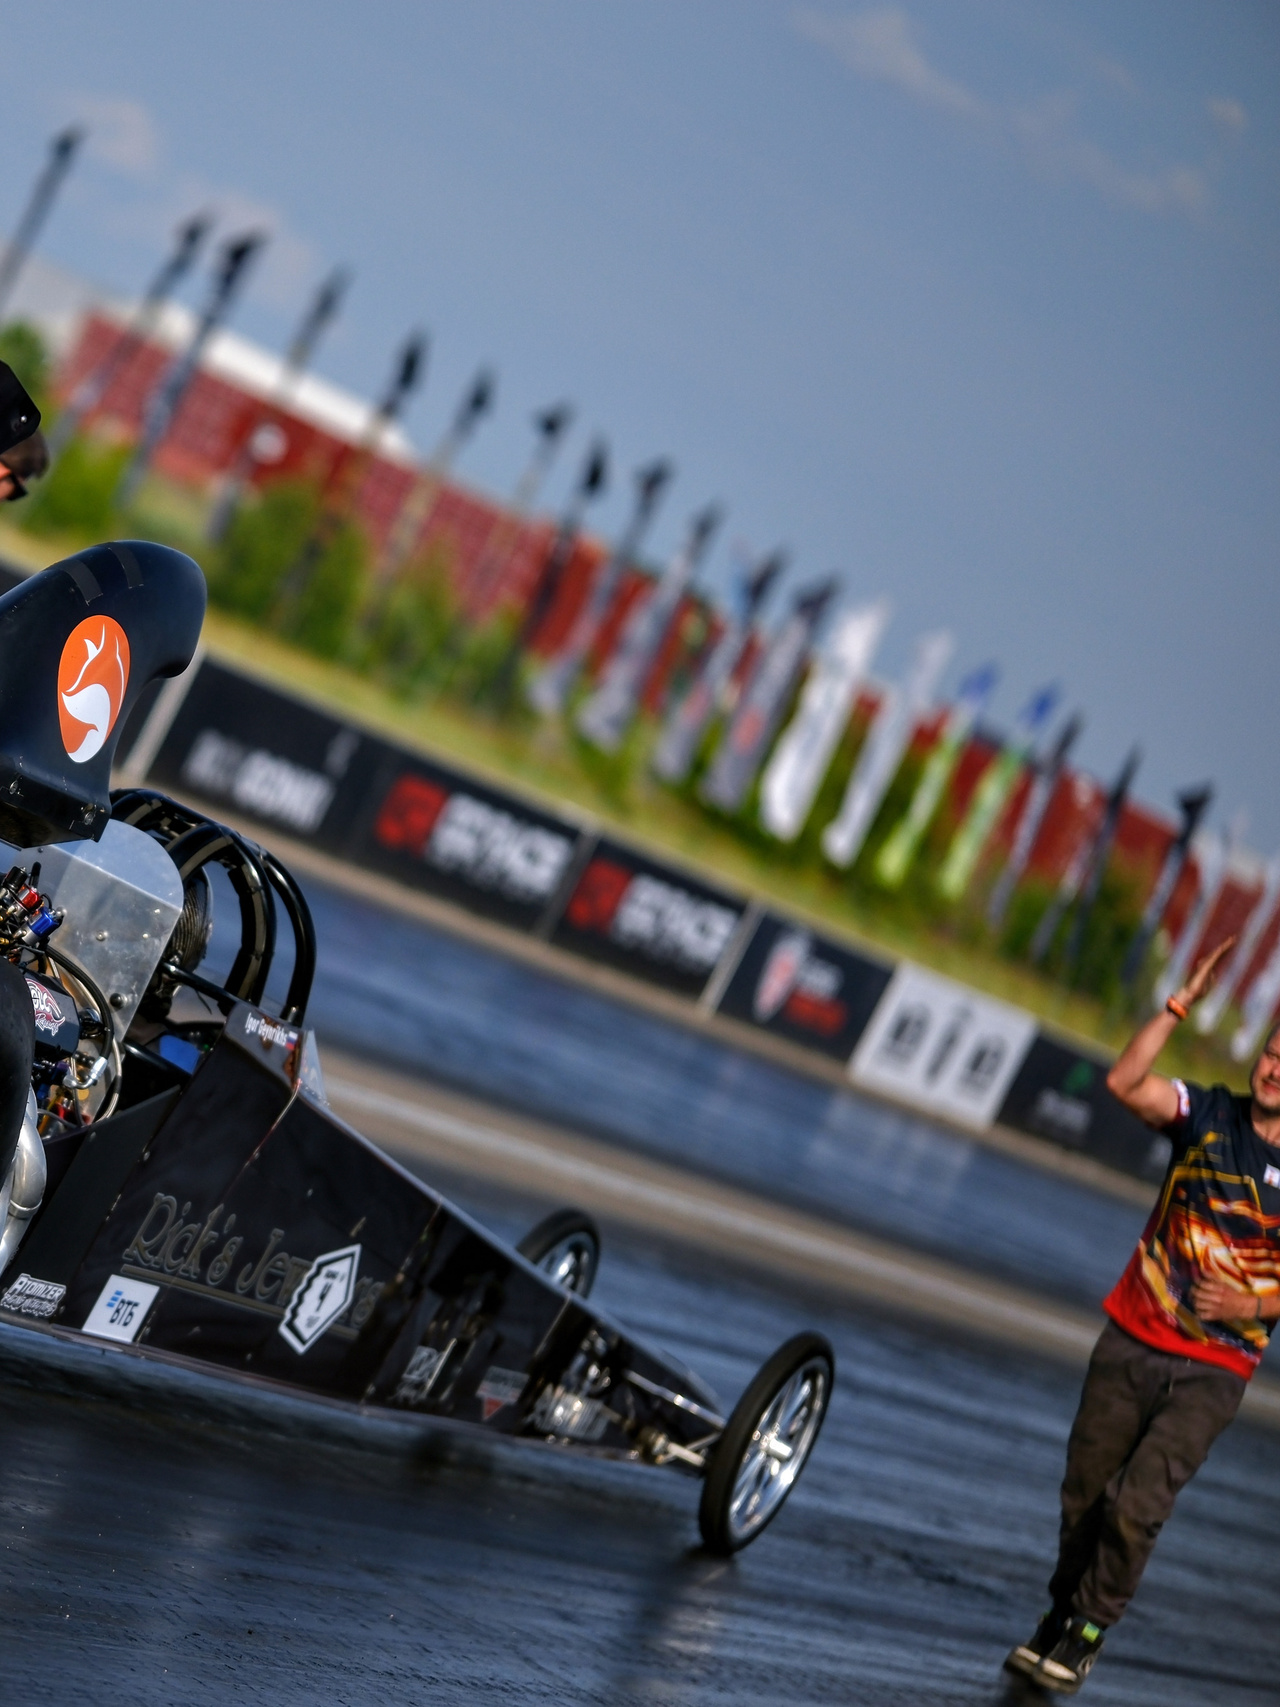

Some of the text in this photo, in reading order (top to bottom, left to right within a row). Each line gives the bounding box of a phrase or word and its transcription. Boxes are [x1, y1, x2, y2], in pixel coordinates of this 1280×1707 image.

[245, 1012, 260, 1034] Igor
[121, 1191, 244, 1287] Rick's
[8, 1275, 64, 1302] ATOMIZER
[109, 1298, 140, 1328] ВТБ
